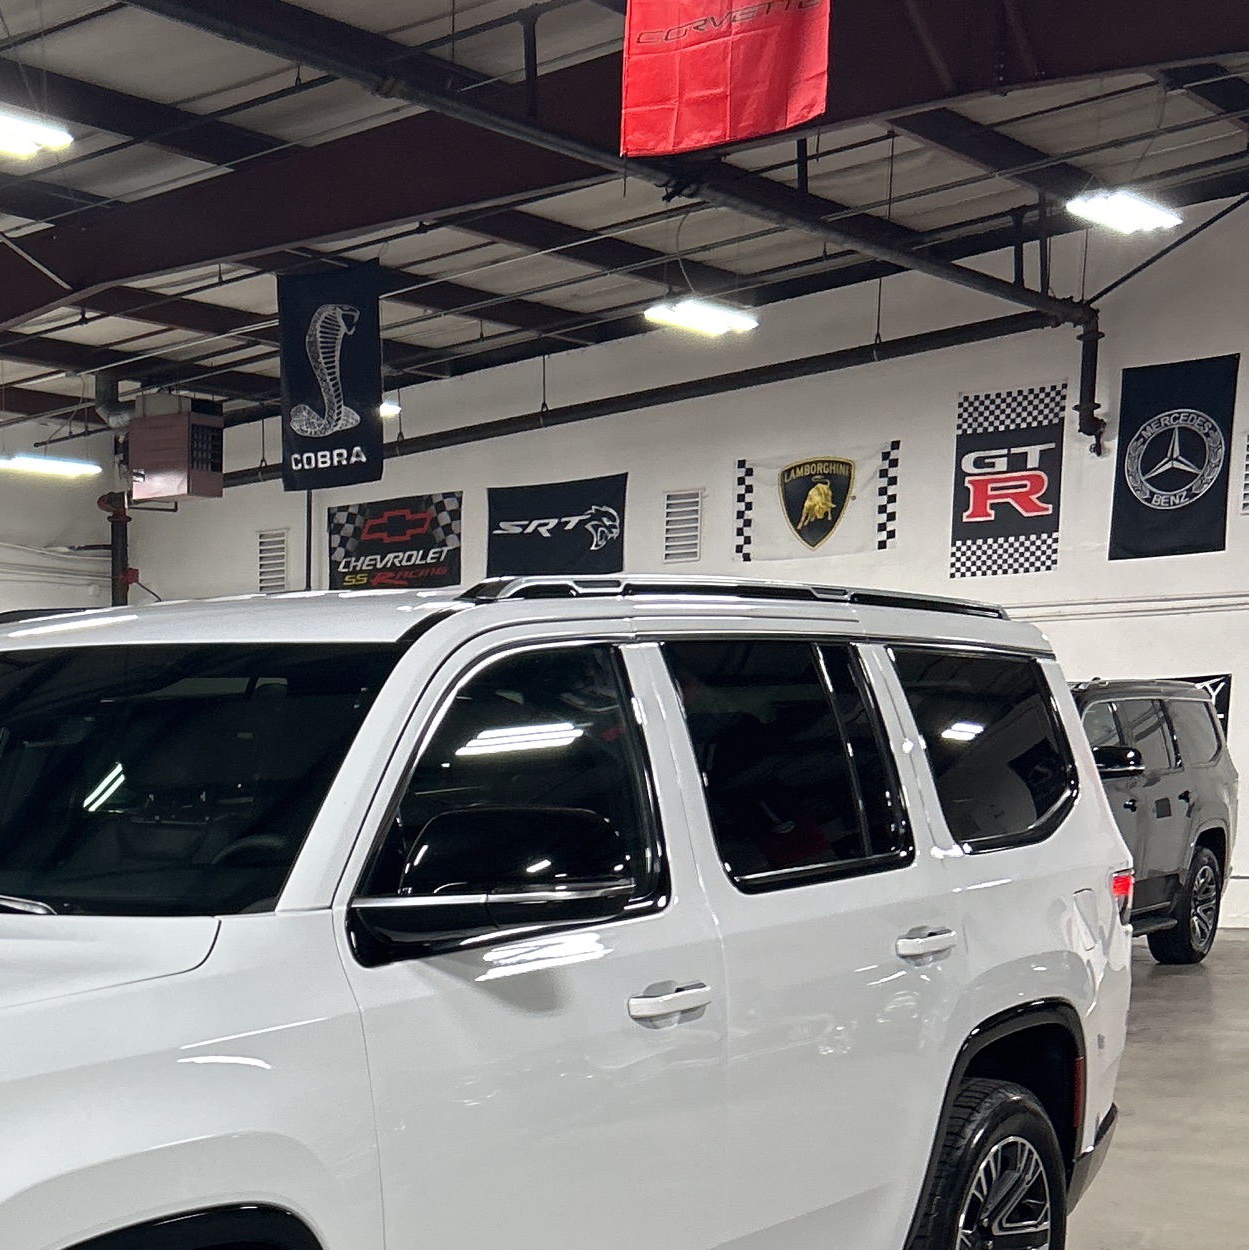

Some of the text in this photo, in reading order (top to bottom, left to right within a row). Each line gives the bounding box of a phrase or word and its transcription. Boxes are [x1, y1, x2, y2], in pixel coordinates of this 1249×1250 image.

[1141, 413, 1211, 440] MERCEDES
[291, 446, 367, 470] COBRA
[961, 442, 1056, 474] GT
[784, 462, 850, 482] LAMBORGHINI
[962, 470, 1053, 522] R
[1151, 491, 1190, 507] BENZ
[492, 514, 592, 537] SRT
[338, 546, 457, 572] CHEVROLET
[343, 573, 368, 586] SS
